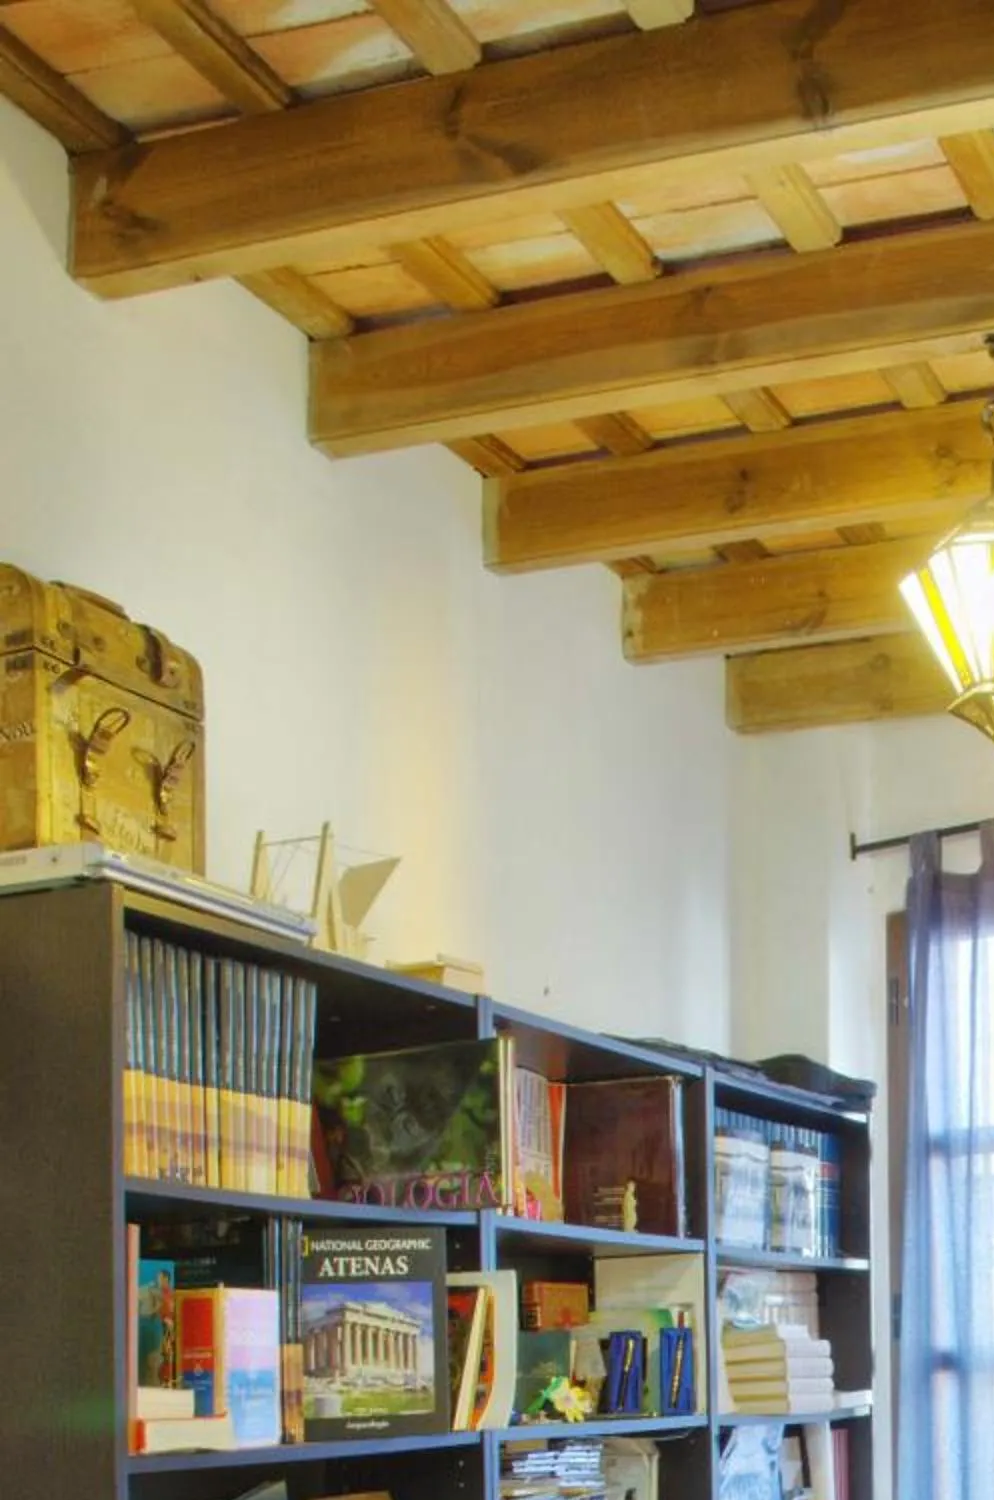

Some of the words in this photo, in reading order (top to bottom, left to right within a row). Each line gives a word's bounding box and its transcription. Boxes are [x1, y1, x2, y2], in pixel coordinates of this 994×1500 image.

[312, 1239, 362, 1252] NATIONAL
[364, 1238, 432, 1251] GEOGRAPHIC
[319, 1255, 409, 1277] ATENAS
